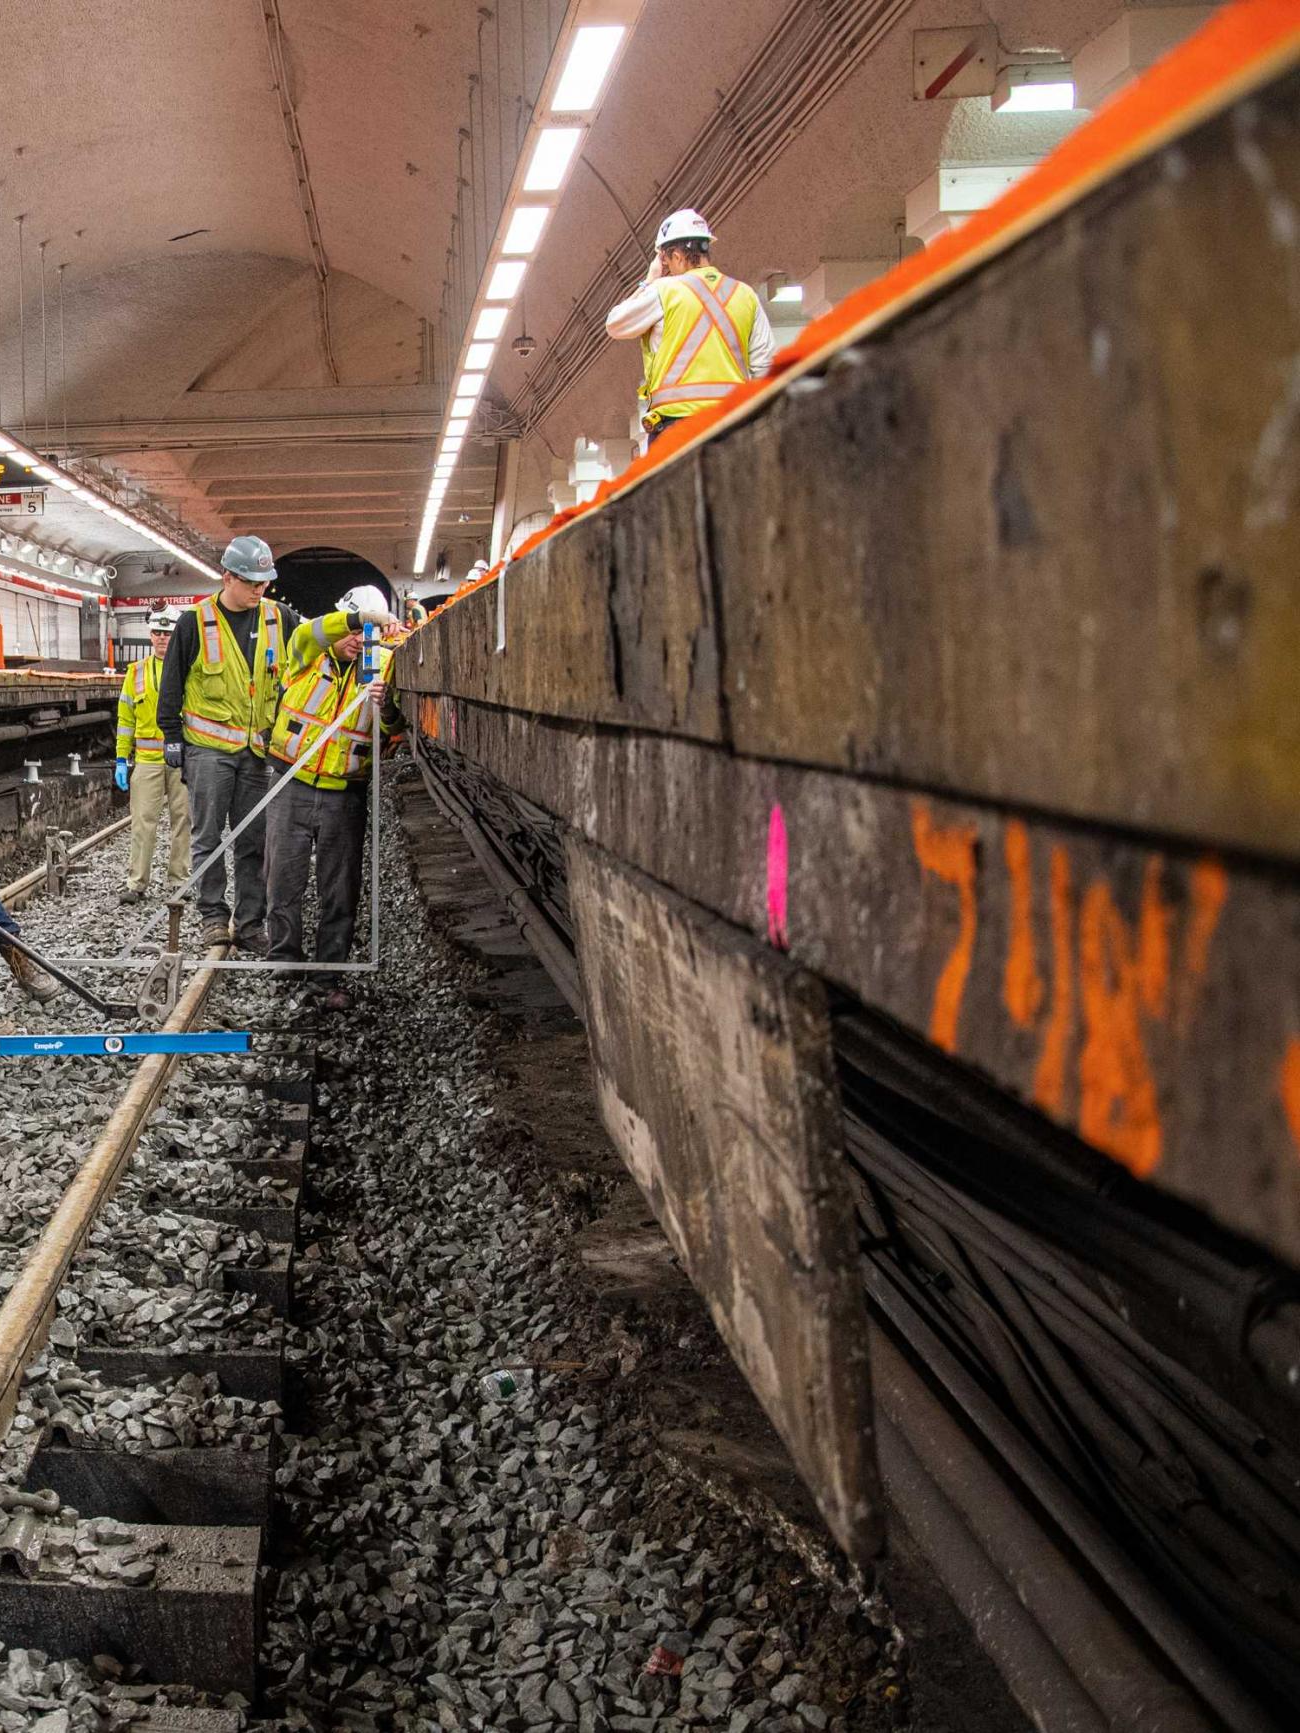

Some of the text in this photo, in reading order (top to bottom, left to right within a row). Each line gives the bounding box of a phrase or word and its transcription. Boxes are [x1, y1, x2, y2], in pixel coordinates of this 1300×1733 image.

[27, 501, 37, 513] 5
[163, 596, 195, 605] STREET
[33, 1041, 64, 1051] Empire
